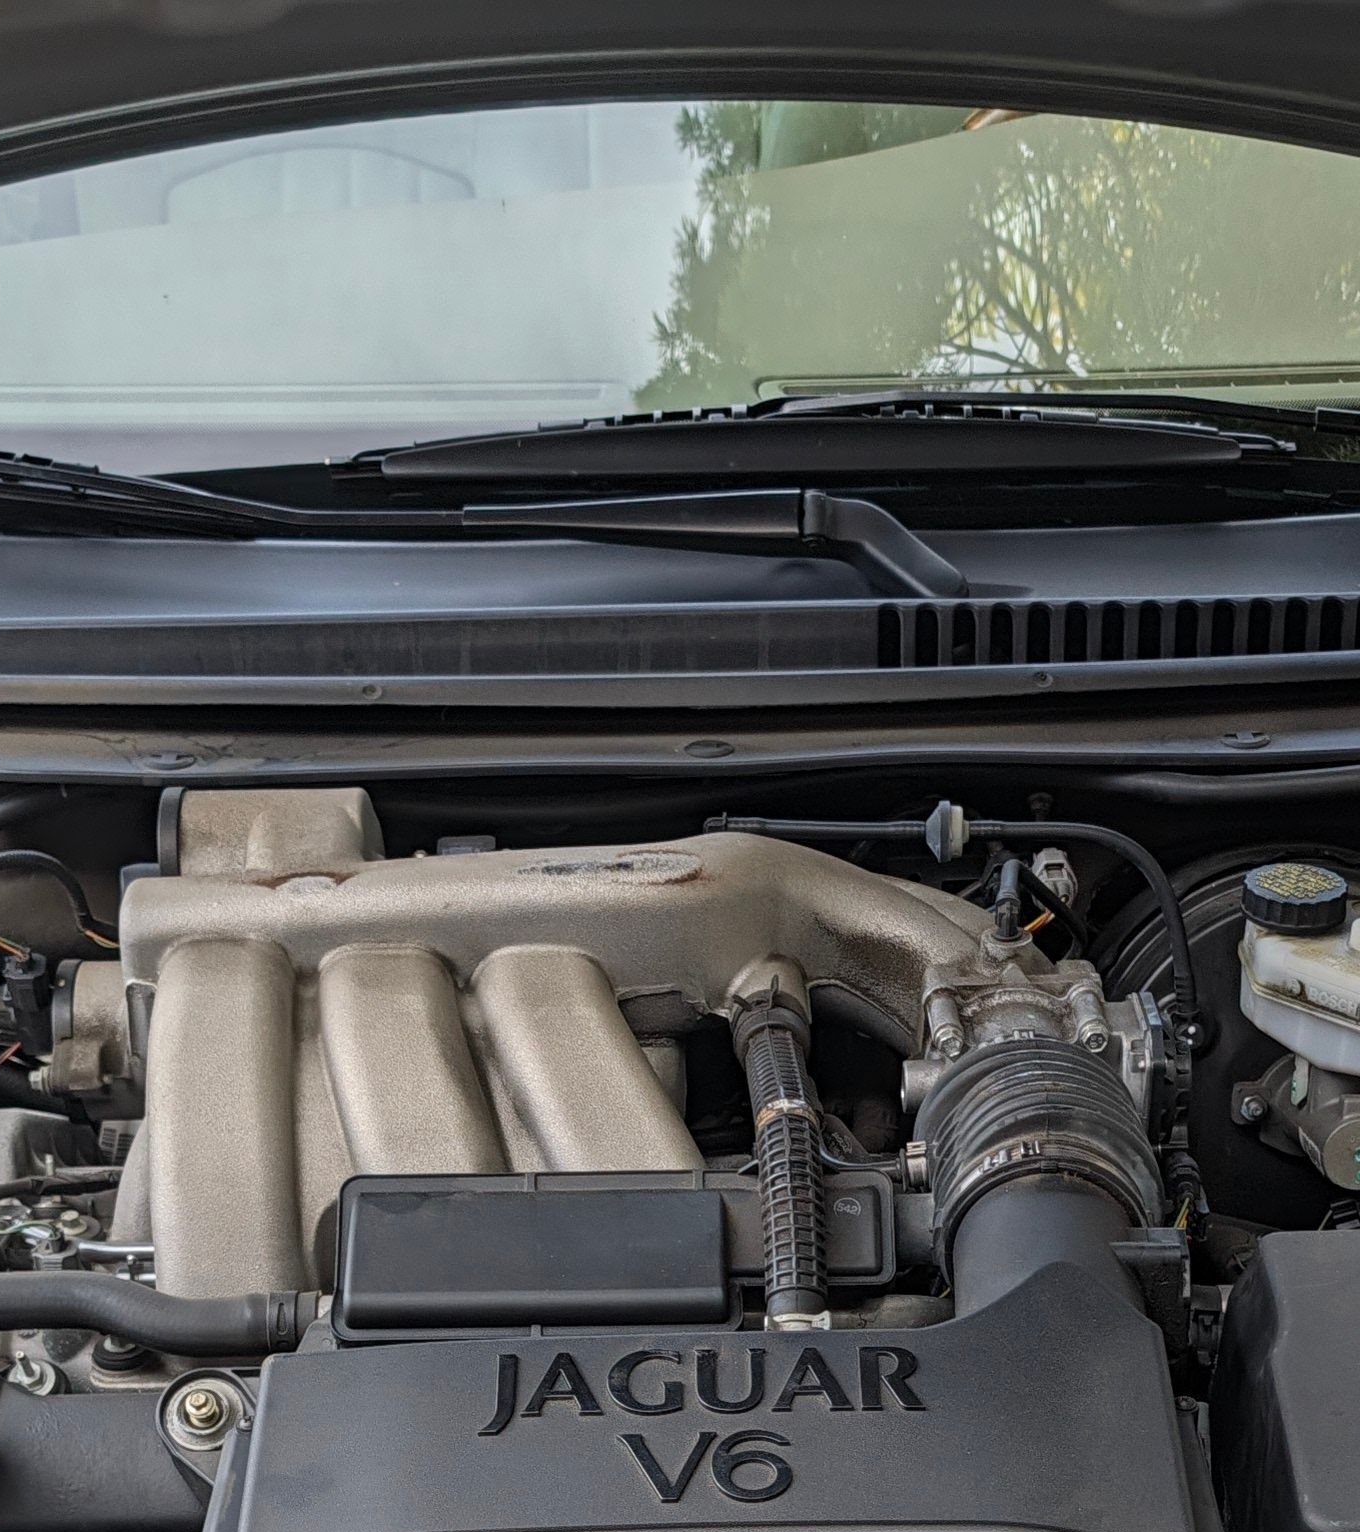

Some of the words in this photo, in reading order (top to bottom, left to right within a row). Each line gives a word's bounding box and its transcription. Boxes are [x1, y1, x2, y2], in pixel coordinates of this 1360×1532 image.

[1308, 986, 1360, 1015] BOSCH
[478, 1346, 927, 1437] JAGUAR
[616, 1429, 794, 1504] V6
